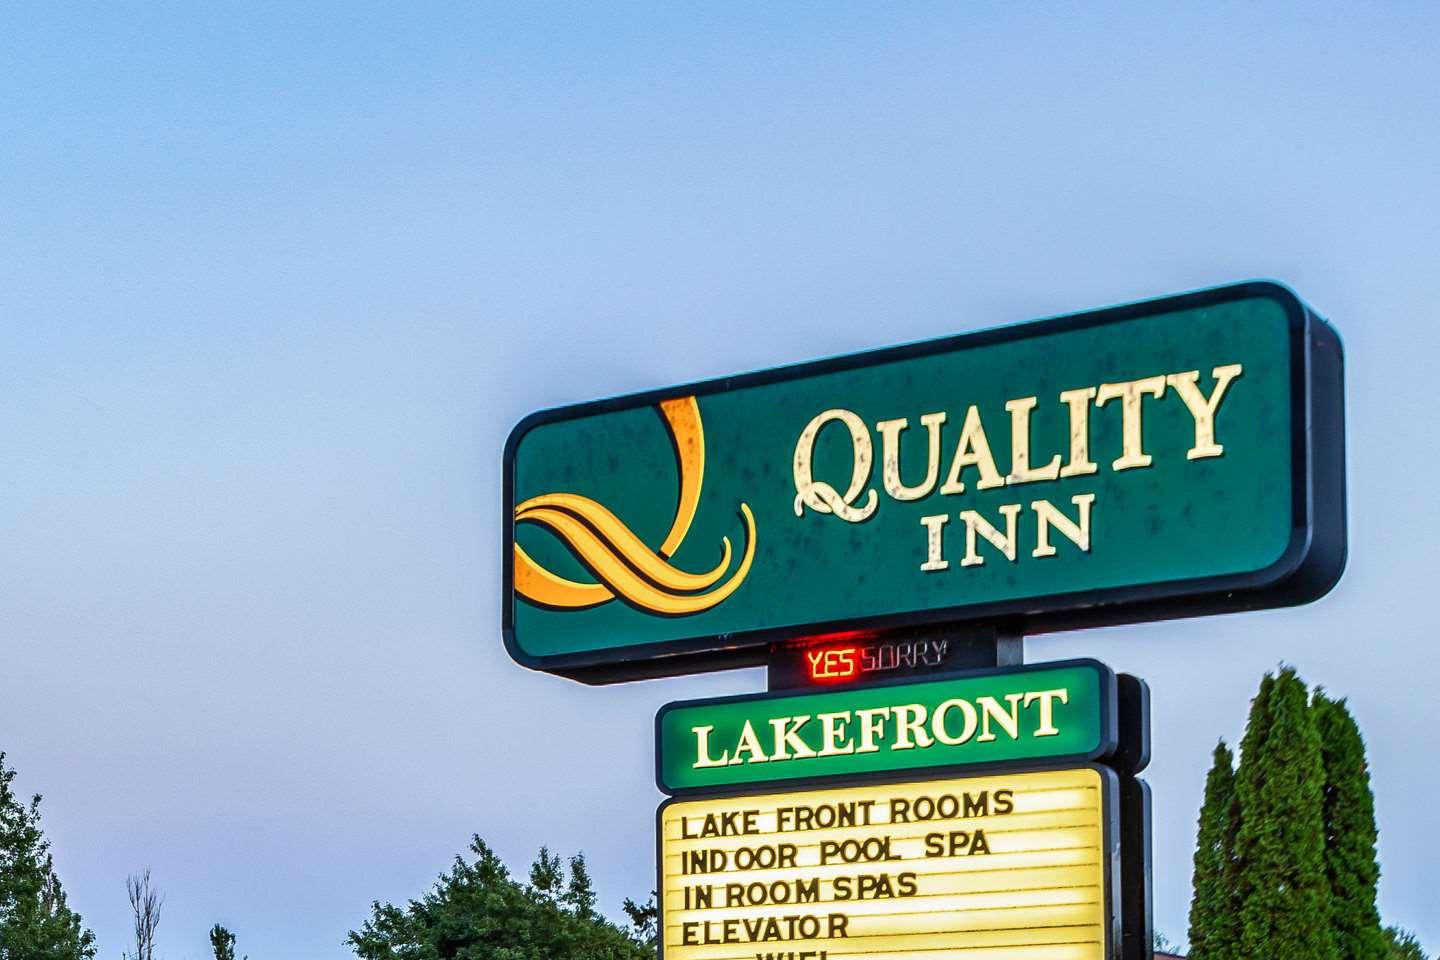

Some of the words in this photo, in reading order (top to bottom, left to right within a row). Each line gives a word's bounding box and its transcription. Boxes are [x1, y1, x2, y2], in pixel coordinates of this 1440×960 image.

[793, 363, 1242, 523] QUALITY
[920, 493, 1096, 571] INN
[808, 649, 856, 678] YES
[861, 640, 948, 671] SORRY
[691, 688, 1069, 769] LAKEFRONT
[681, 809, 760, 840] LAKE
[776, 800, 875, 833] FRONT
[889, 790, 1015, 824] ROOMS
[681, 844, 798, 876] INDOOR
[820, 836, 901, 866] POOL
[925, 829, 991, 859] SPA
[684, 884, 713, 911] IN
[725, 878, 820, 909] ROOM
[833, 872, 918, 901] SPAS
[682, 913, 849, 946] ELEVATOR
